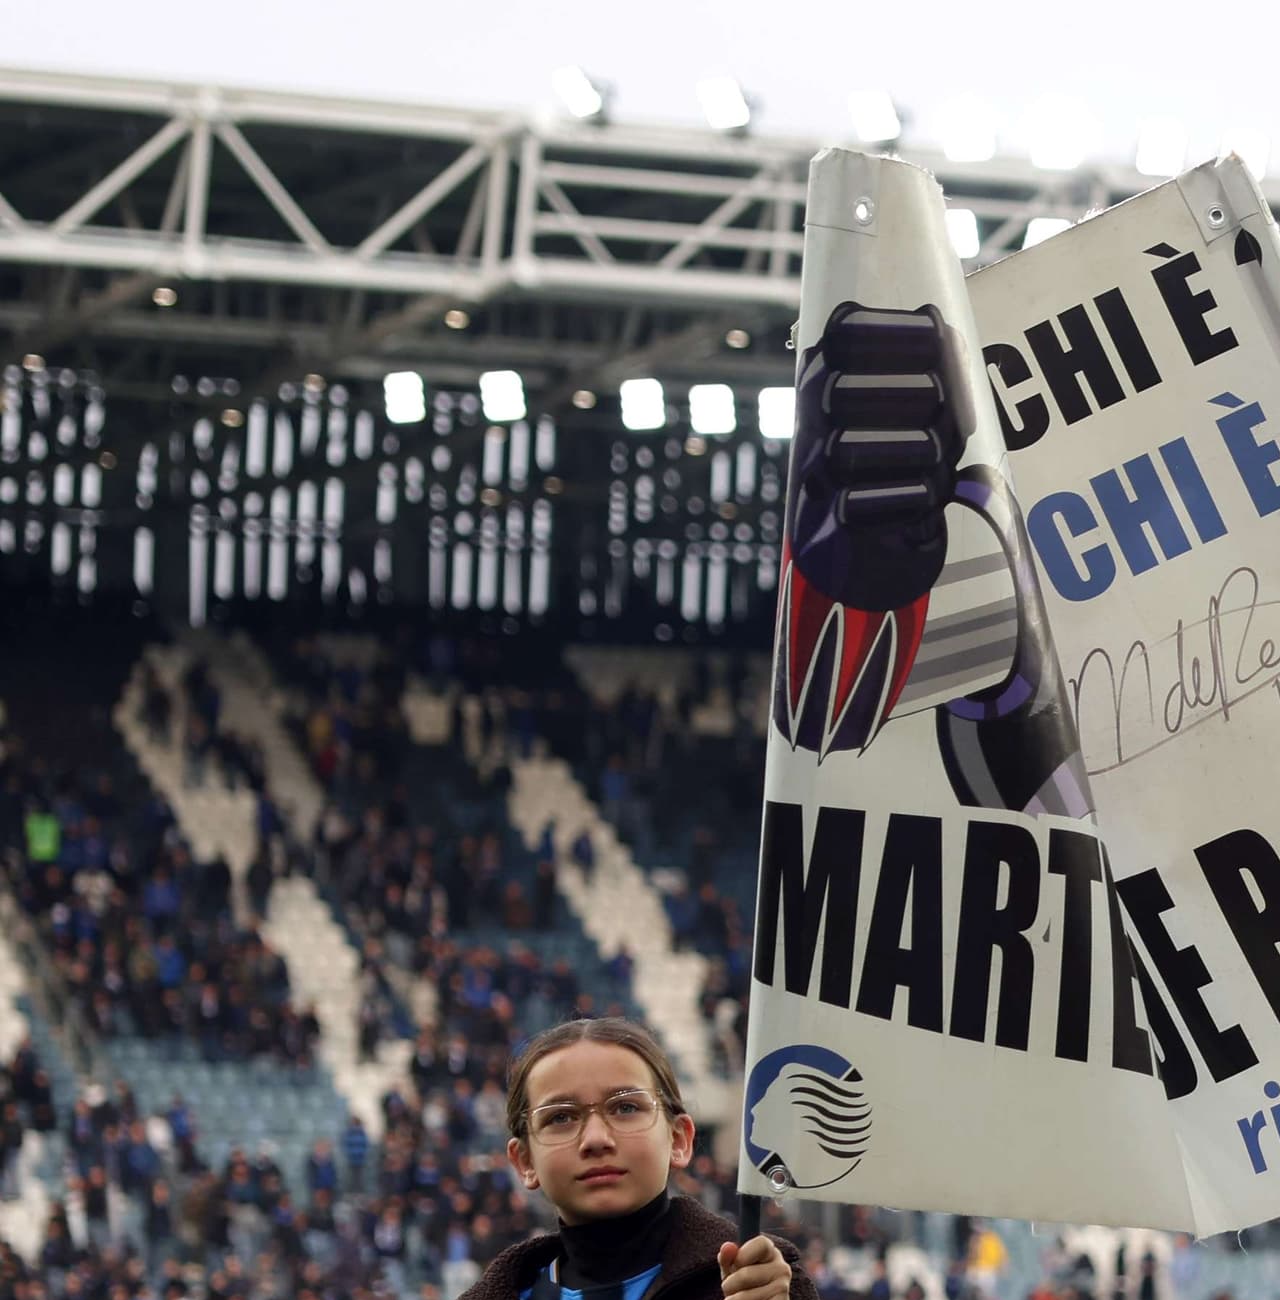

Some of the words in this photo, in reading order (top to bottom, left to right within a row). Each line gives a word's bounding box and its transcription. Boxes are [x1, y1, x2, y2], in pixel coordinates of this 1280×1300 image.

[984, 287, 1163, 451] CHI
[1144, 243, 1239, 366] È
[1027, 438, 1229, 602] CHI
